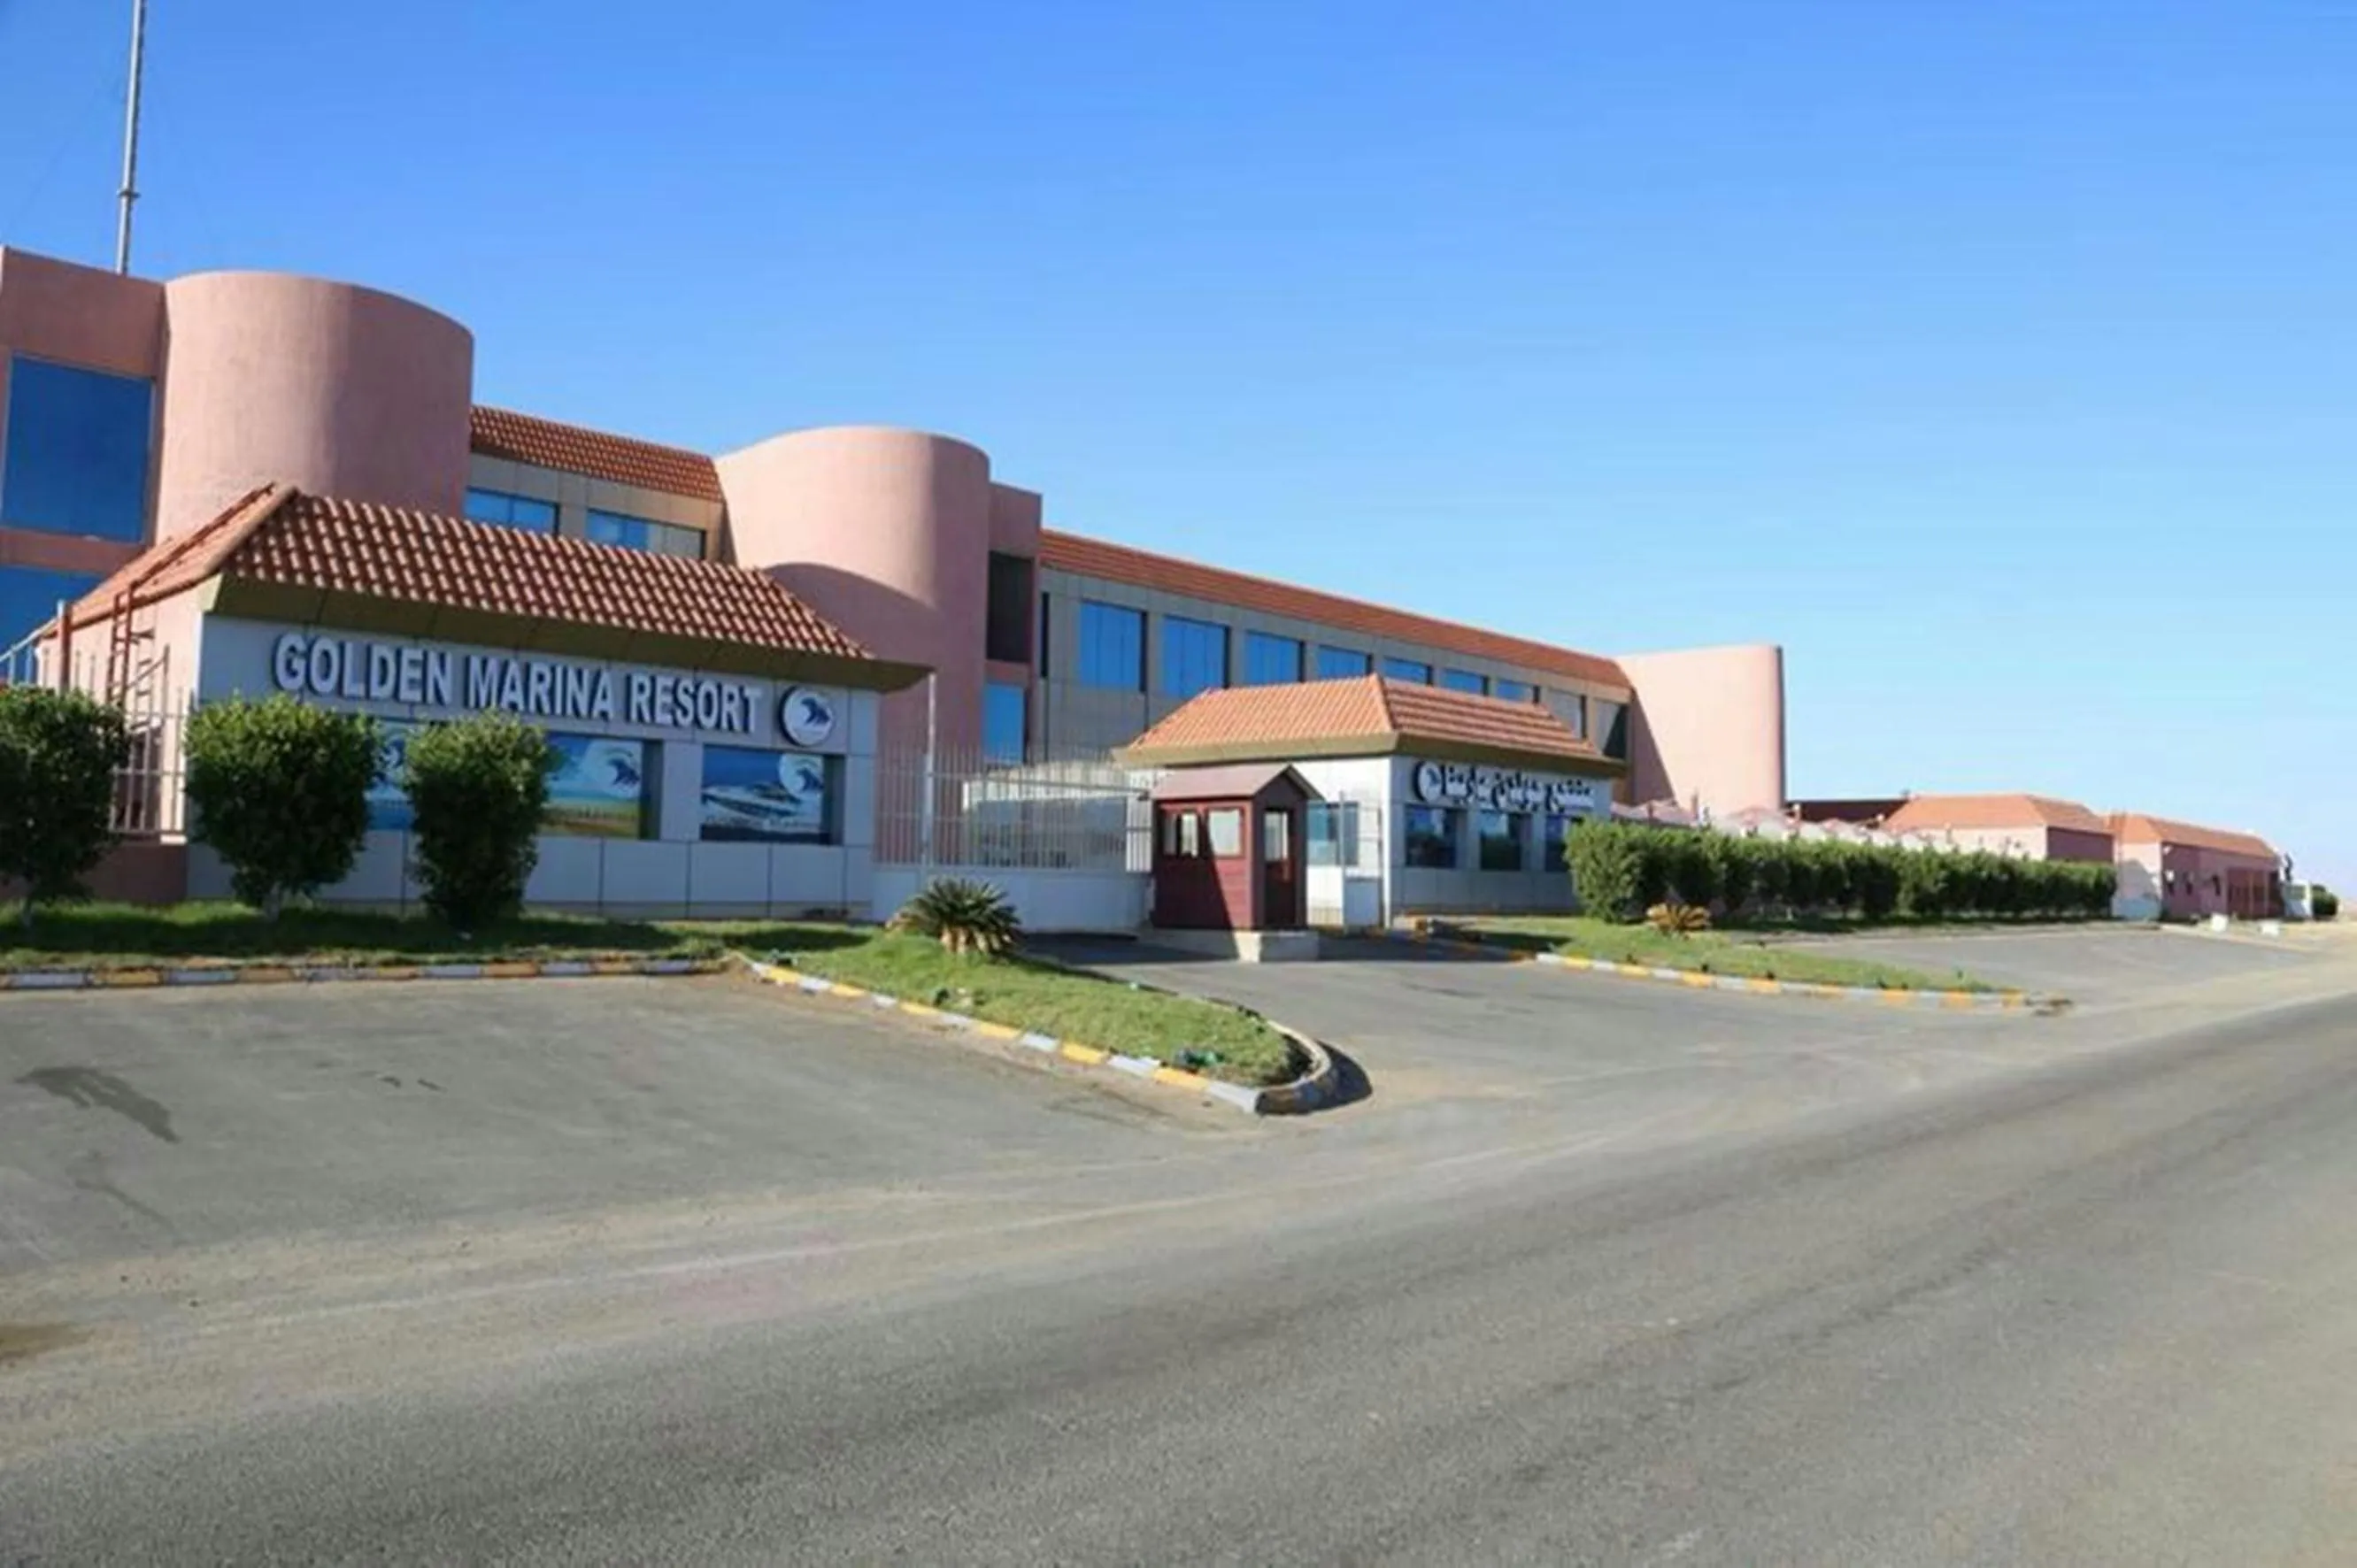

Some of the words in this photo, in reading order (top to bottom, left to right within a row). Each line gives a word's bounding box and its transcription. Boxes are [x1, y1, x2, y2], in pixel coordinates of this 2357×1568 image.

[273, 633, 452, 704] GOLDEN
[467, 655, 614, 721] MARINA
[625, 673, 762, 734] RESORT
